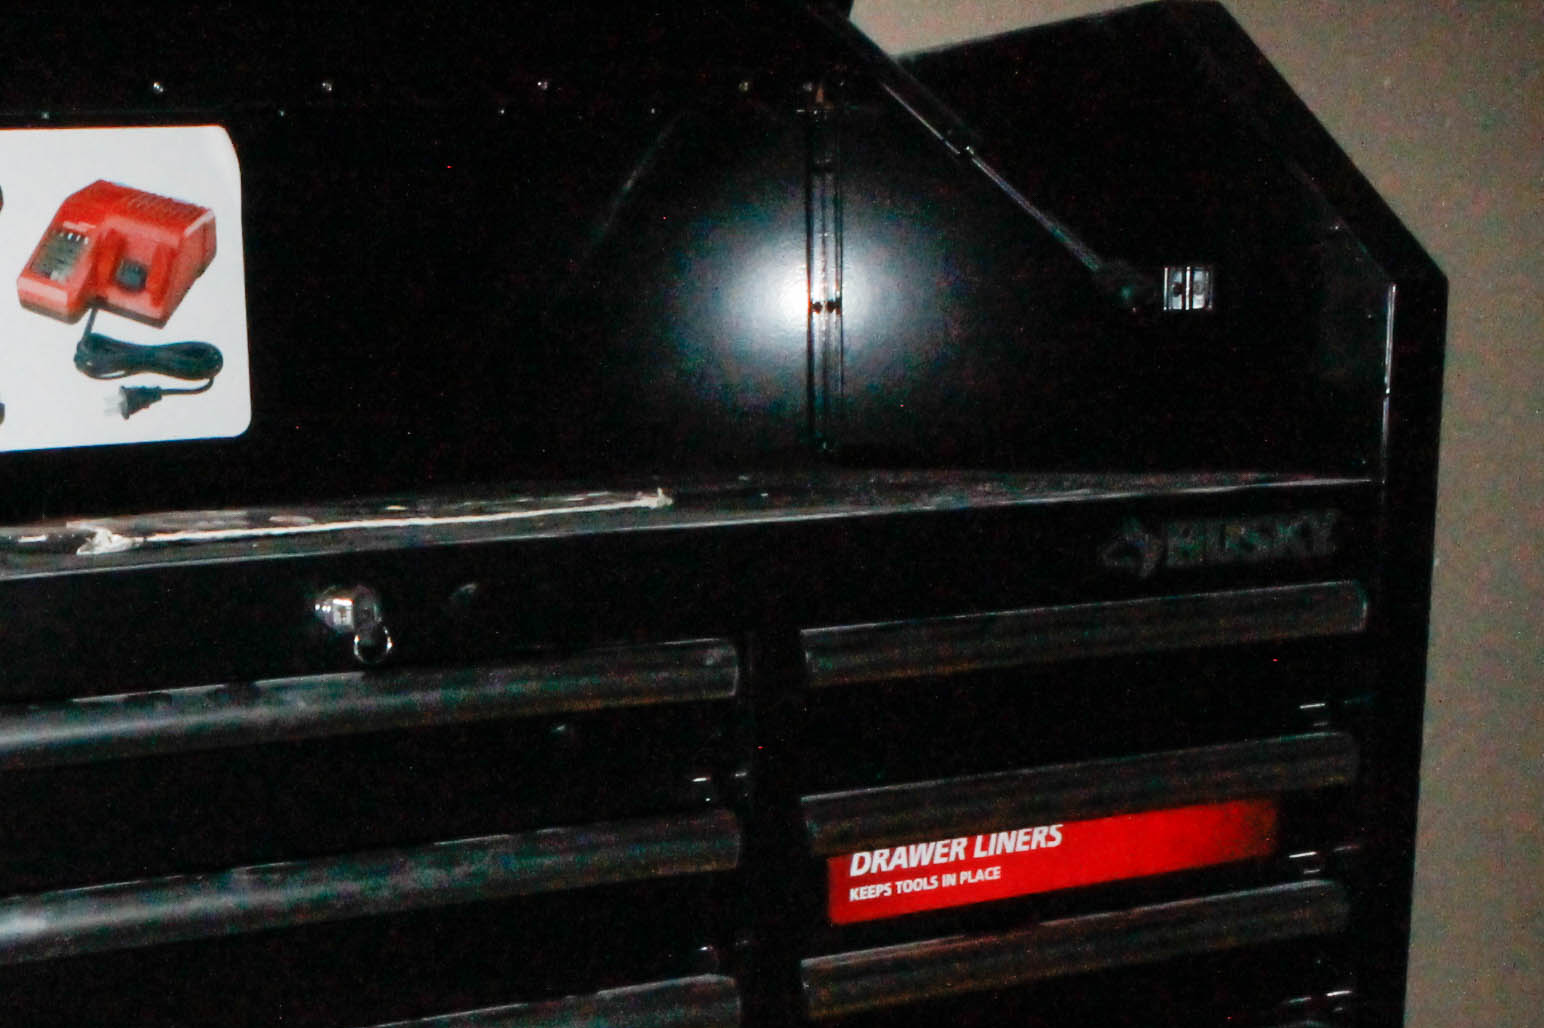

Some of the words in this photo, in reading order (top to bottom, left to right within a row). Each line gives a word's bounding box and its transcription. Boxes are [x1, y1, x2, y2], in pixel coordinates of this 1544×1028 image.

[1164, 509, 1341, 567] HUSKY
[850, 837, 967, 877] DRAWER
[973, 824, 1064, 859] LINERS
[849, 882, 892, 902] KEEPS
[896, 875, 938, 894] TOOLS
[942, 873, 956, 888] IN
[959, 866, 1001, 885] PLACE
